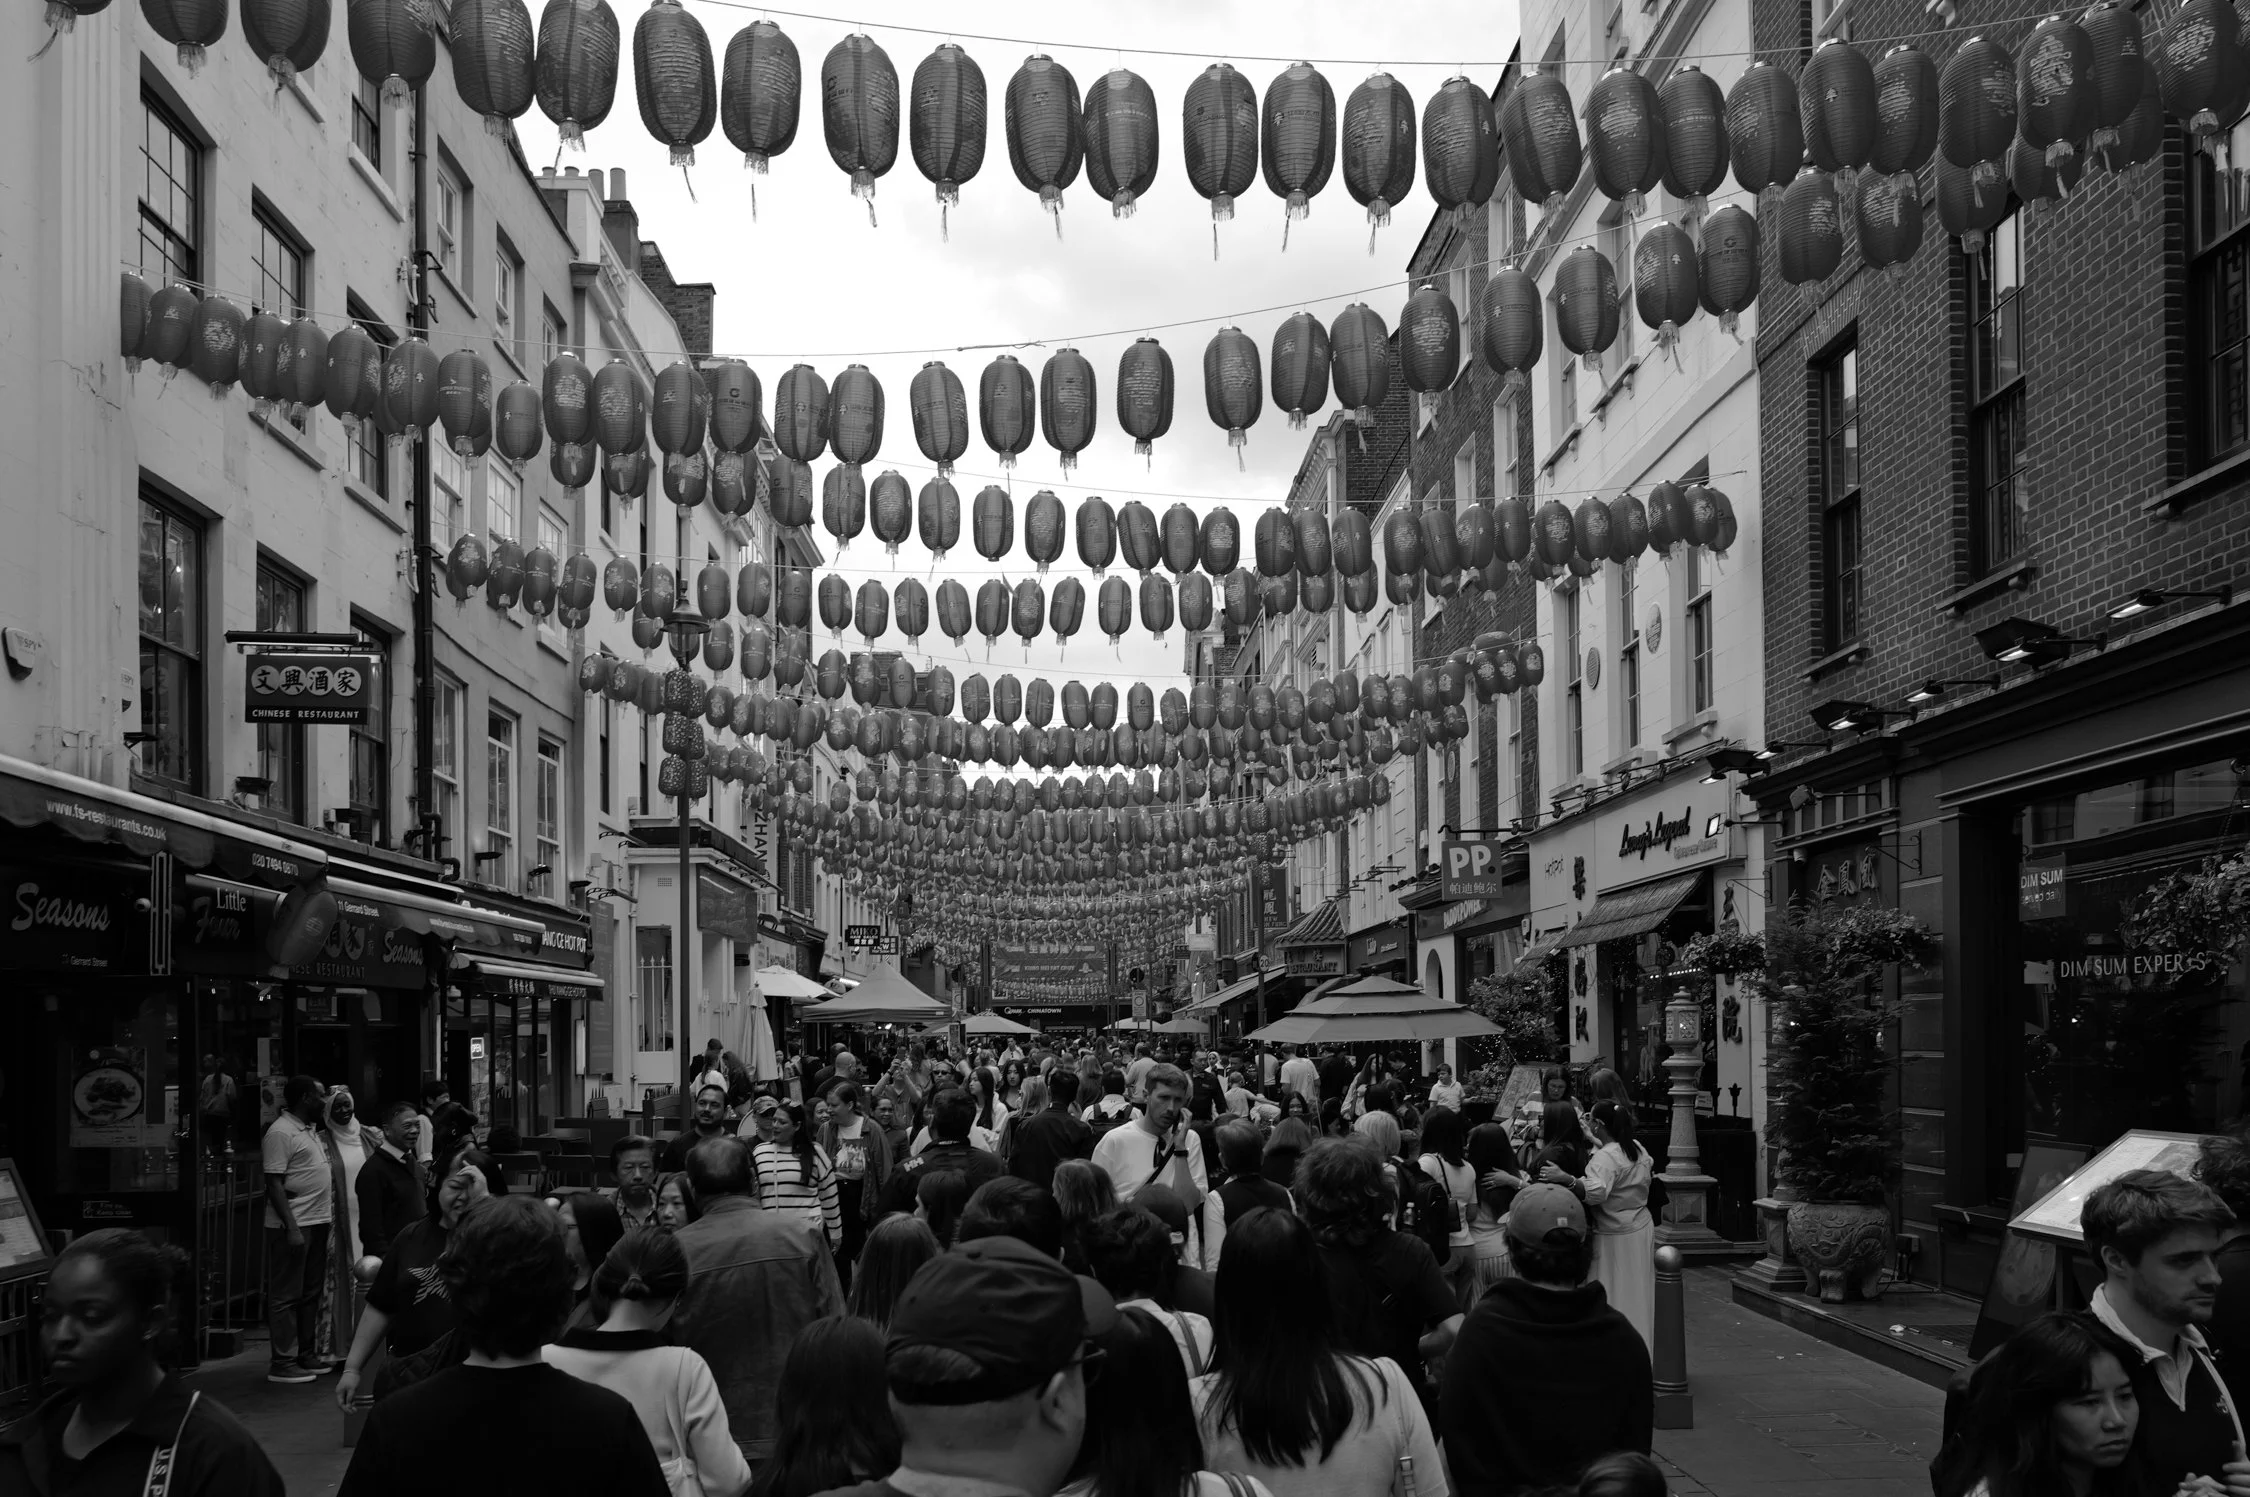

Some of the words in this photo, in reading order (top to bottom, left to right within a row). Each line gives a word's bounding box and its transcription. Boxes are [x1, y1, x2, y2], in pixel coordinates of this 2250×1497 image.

[255, 669, 356, 693] 文興酒家
[252, 709, 290, 718] CHINESE
[298, 710, 359, 719] RESTAURANT
[2021, 873, 2038, 888] DIM
[2040, 869, 2063, 886] SUM
[11, 882, 111, 931] Seasons
[216, 887, 247, 912] Little
[382, 930, 424, 966] Seasons
[2061, 960, 2088, 978] DIM
[2094, 957, 2126, 976] SUM
[2134, 952, 2206, 974] EXPERS
